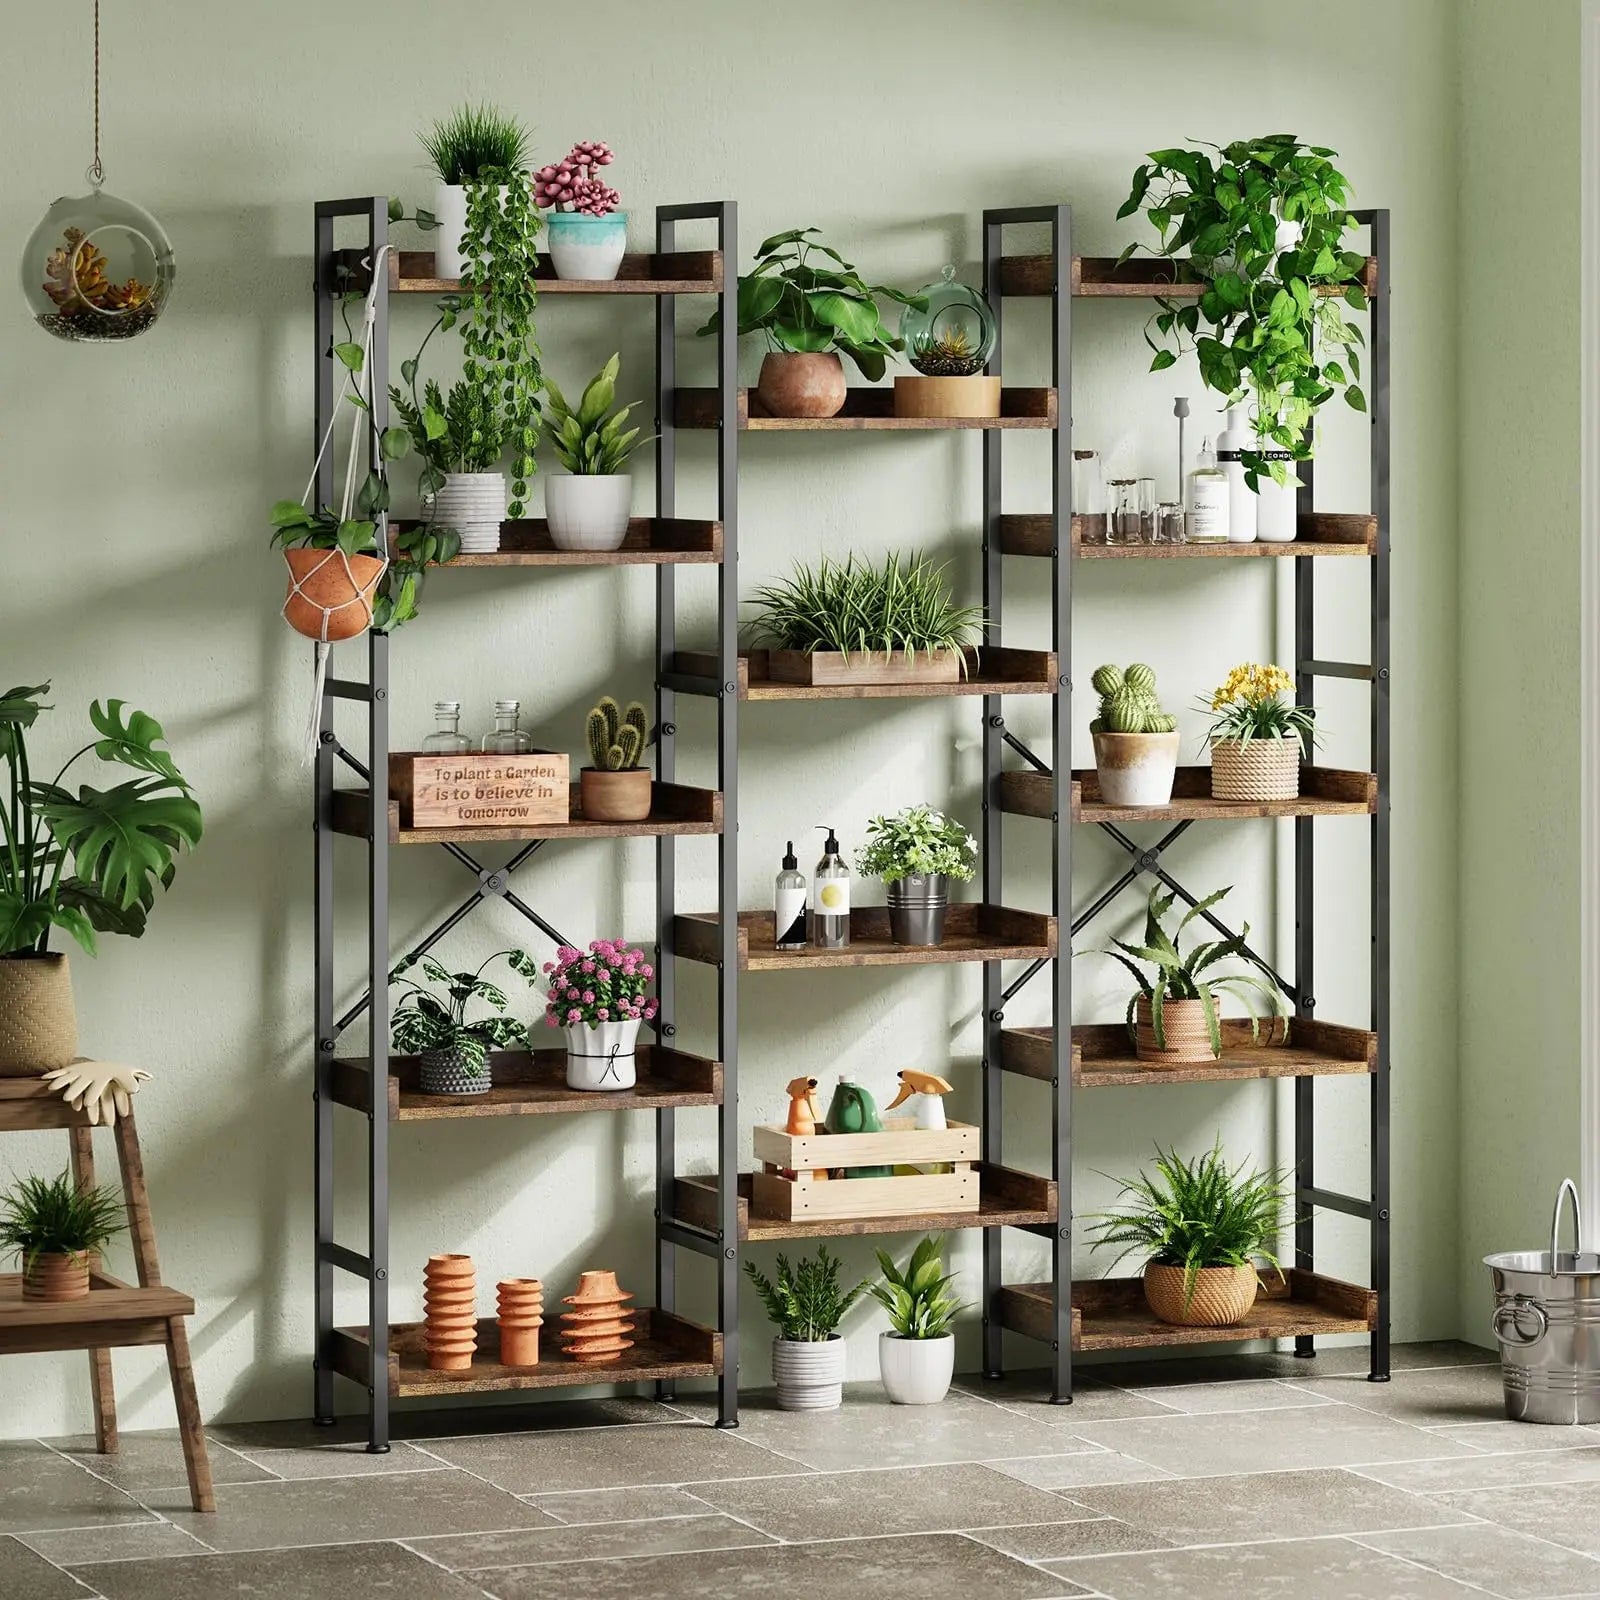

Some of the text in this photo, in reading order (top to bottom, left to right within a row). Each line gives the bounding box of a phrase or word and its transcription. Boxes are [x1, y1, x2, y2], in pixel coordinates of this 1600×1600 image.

[434, 768, 451, 781] To
[454, 767, 491, 783] plant
[505, 765, 556, 779] Garden
[435, 785, 553, 801] is to believe in
[457, 806, 530, 819] tomorrow
